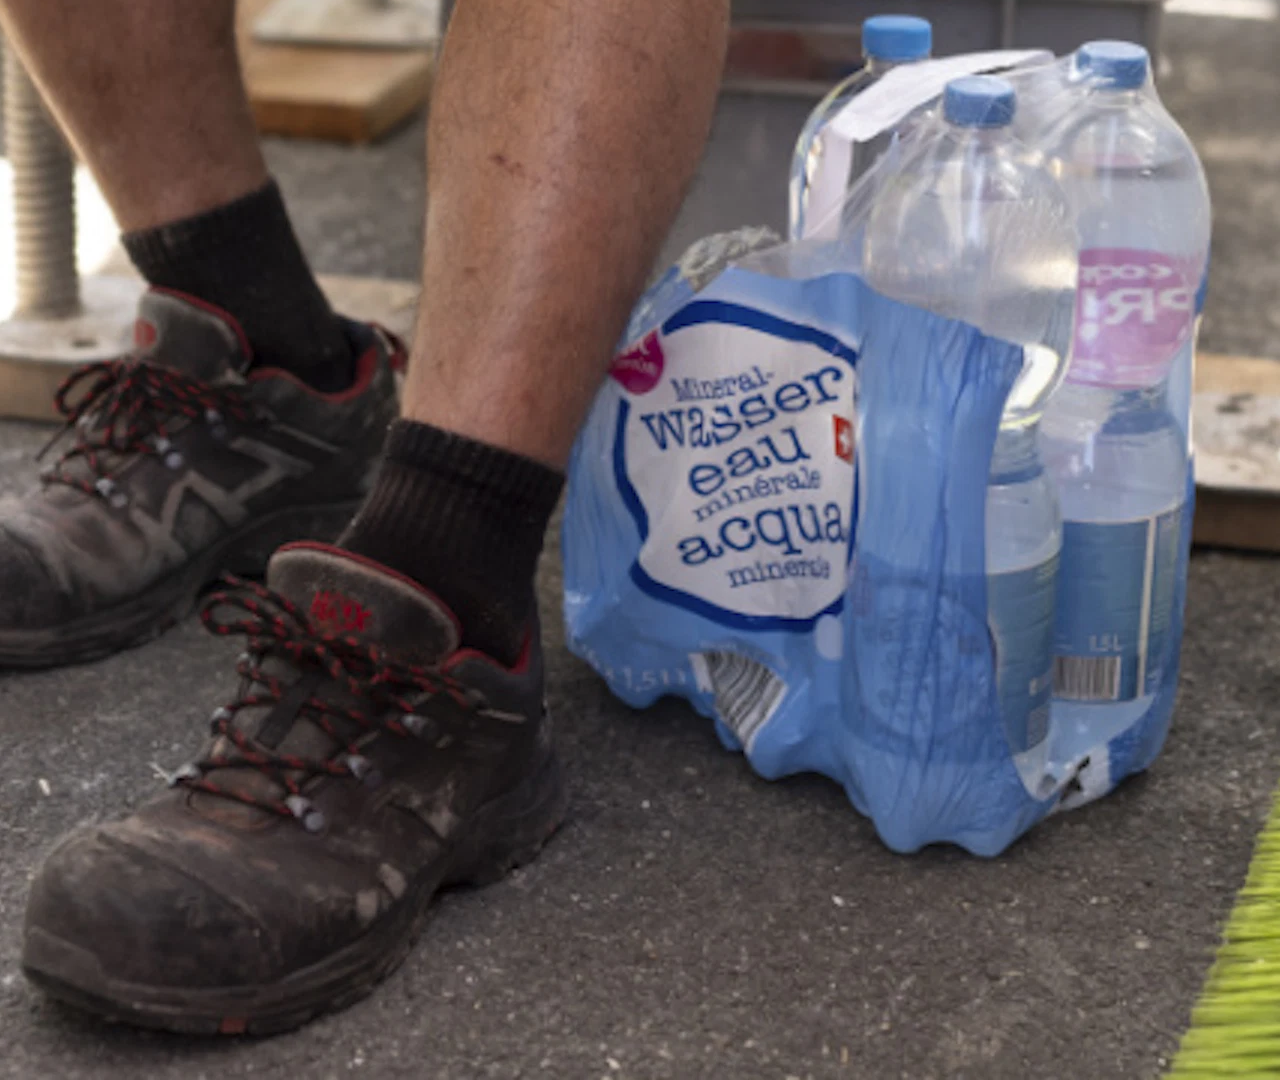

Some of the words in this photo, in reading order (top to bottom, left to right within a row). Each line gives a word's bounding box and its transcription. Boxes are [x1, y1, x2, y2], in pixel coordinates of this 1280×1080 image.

[688, 426, 811, 496] eau
[692, 466, 822, 522] minérale
[677, 502, 848, 566] acqua
